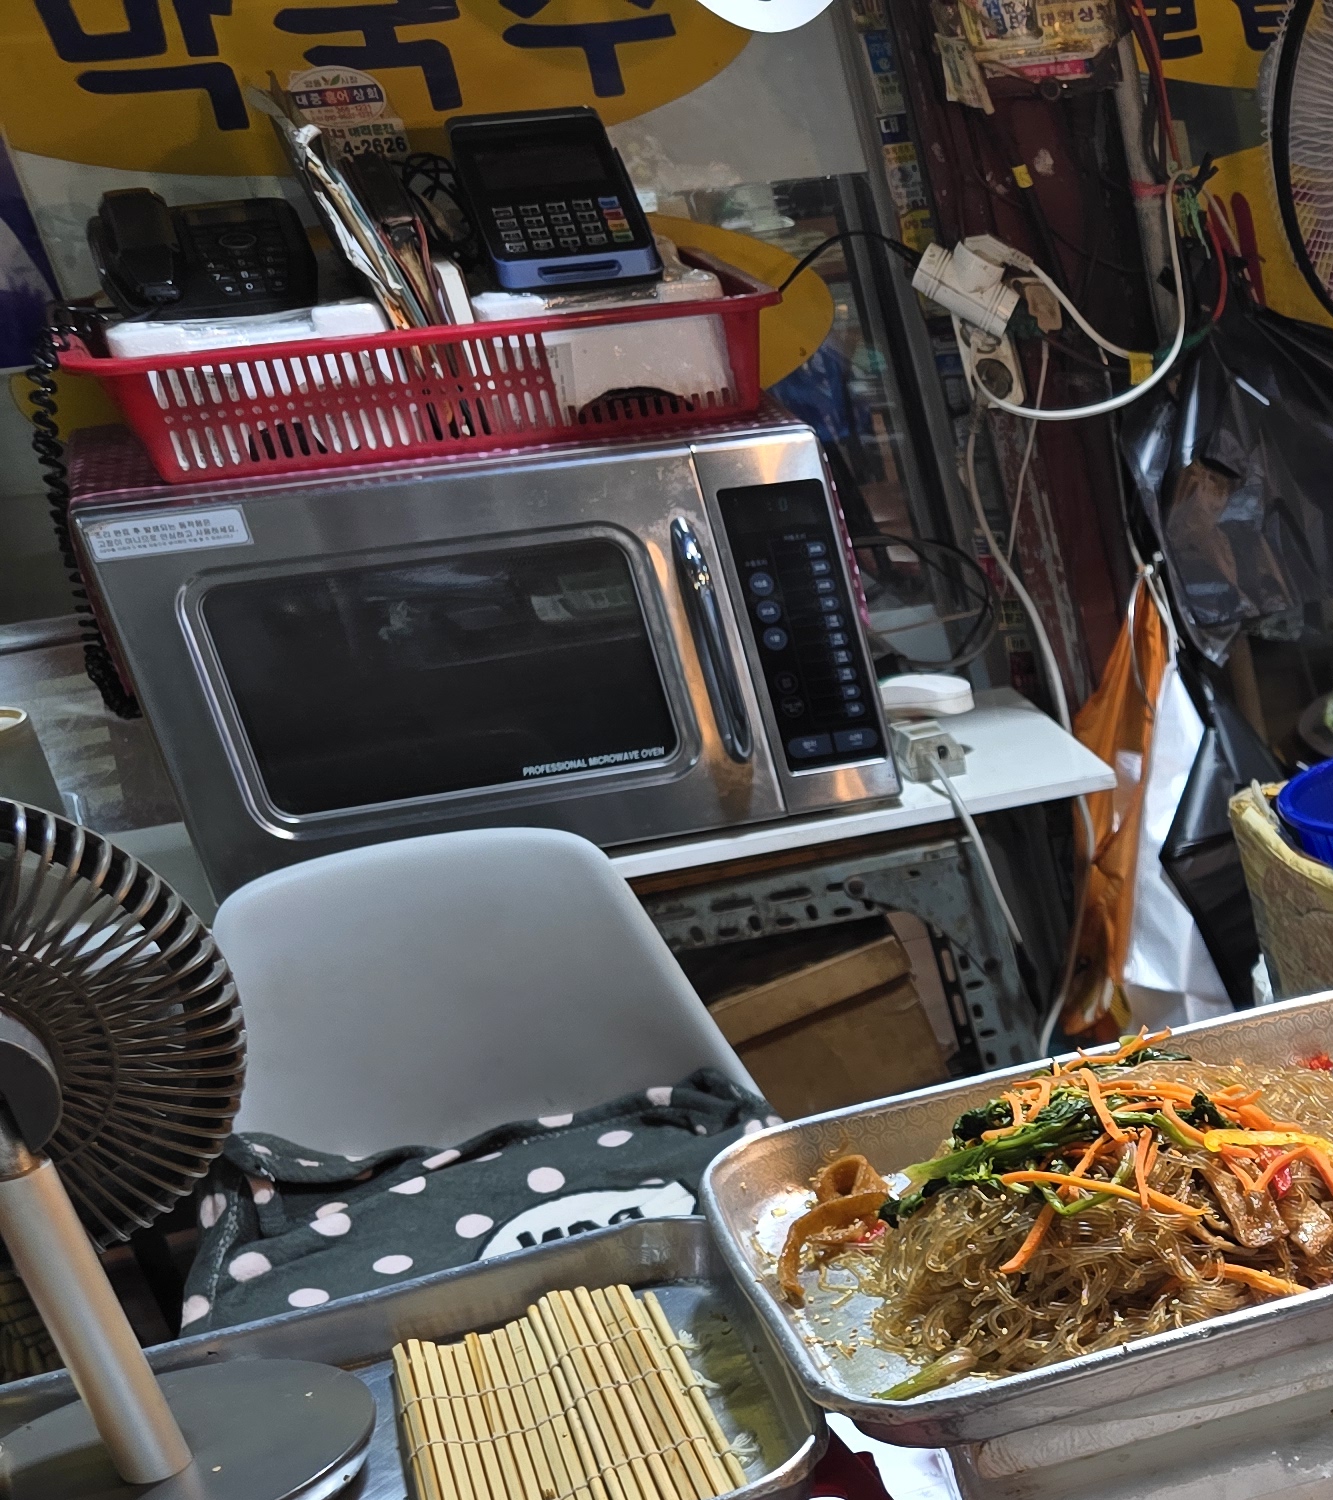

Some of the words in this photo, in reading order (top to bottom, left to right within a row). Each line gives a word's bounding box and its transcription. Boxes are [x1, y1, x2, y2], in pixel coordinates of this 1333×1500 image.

[522, 757, 588, 776] PROFESSIONAL
[588, 750, 640, 767] MICROWAVE
[640, 746, 665, 759] OVEN
